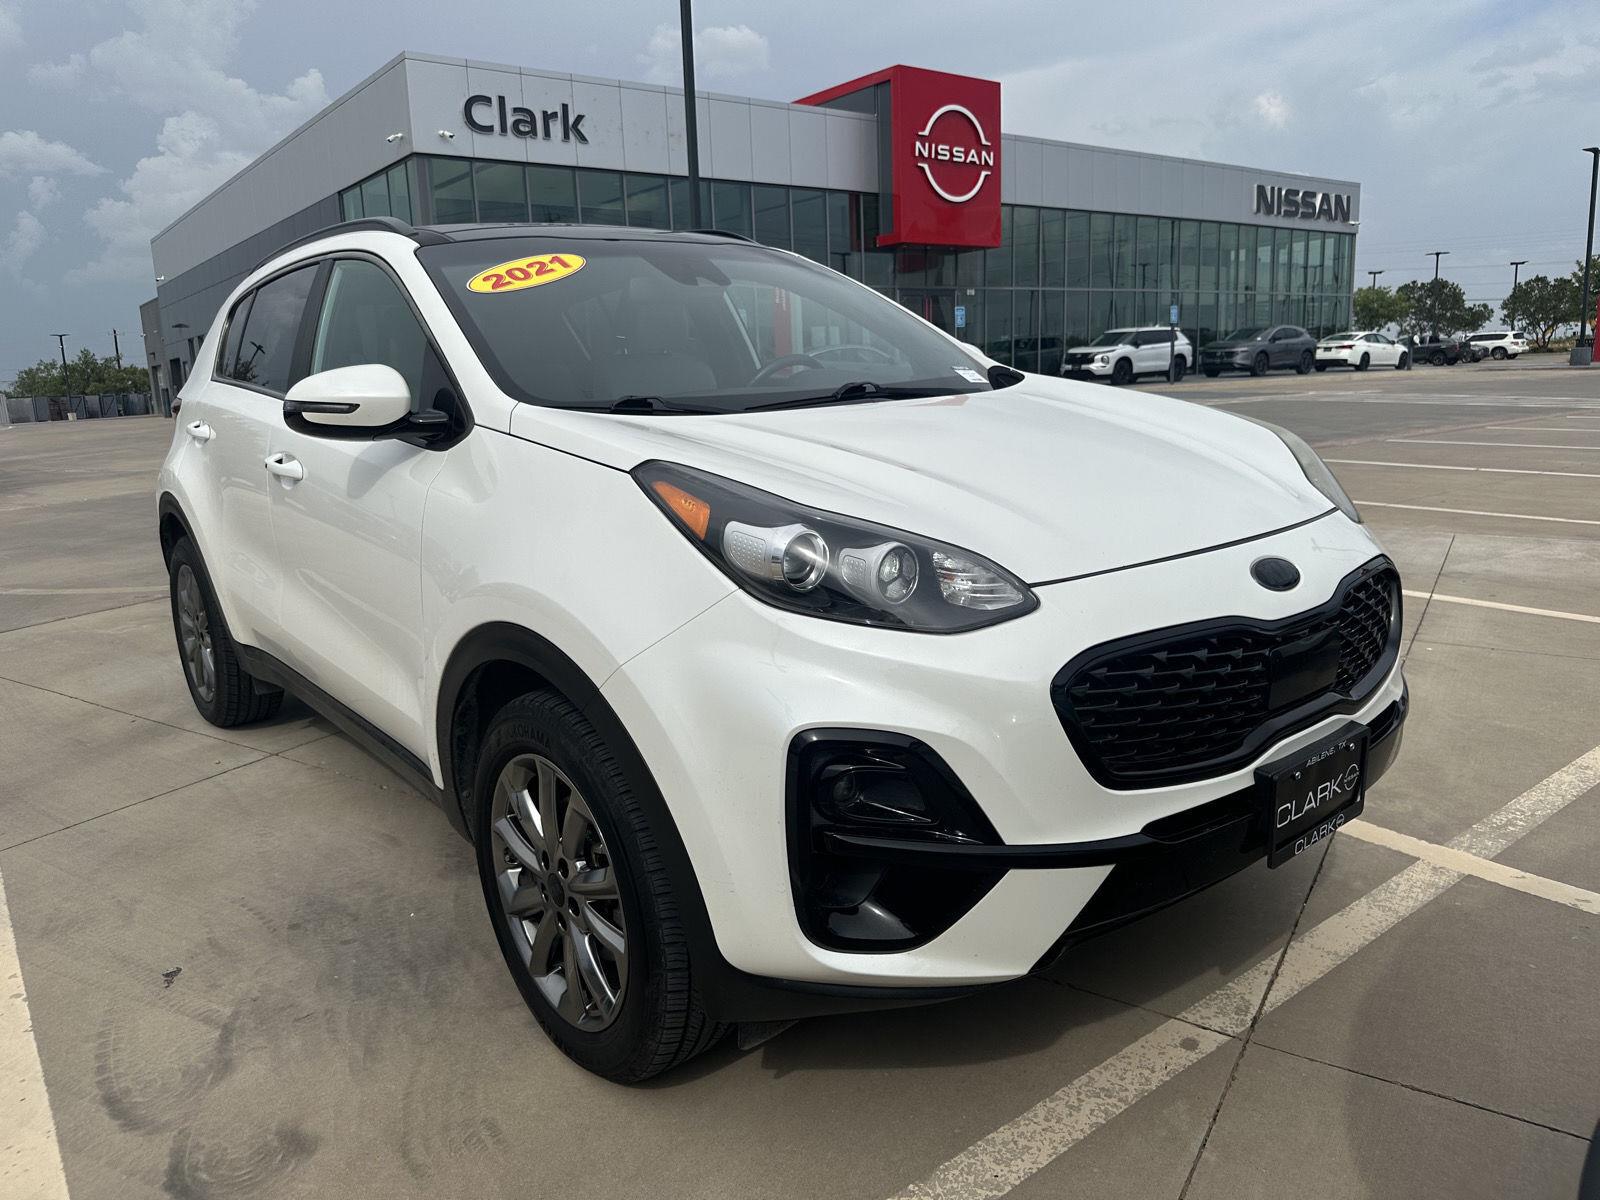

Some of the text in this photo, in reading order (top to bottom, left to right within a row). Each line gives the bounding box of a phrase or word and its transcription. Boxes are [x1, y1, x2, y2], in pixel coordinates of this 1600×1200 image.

[463, 94, 588, 144] Clark
[915, 141, 994, 166] NISSAN
[1255, 184, 1351, 222] NISSAN
[482, 255, 573, 290] 2021
[1276, 773, 1343, 829] CLARK
[1294, 820, 1335, 855] CLARK
